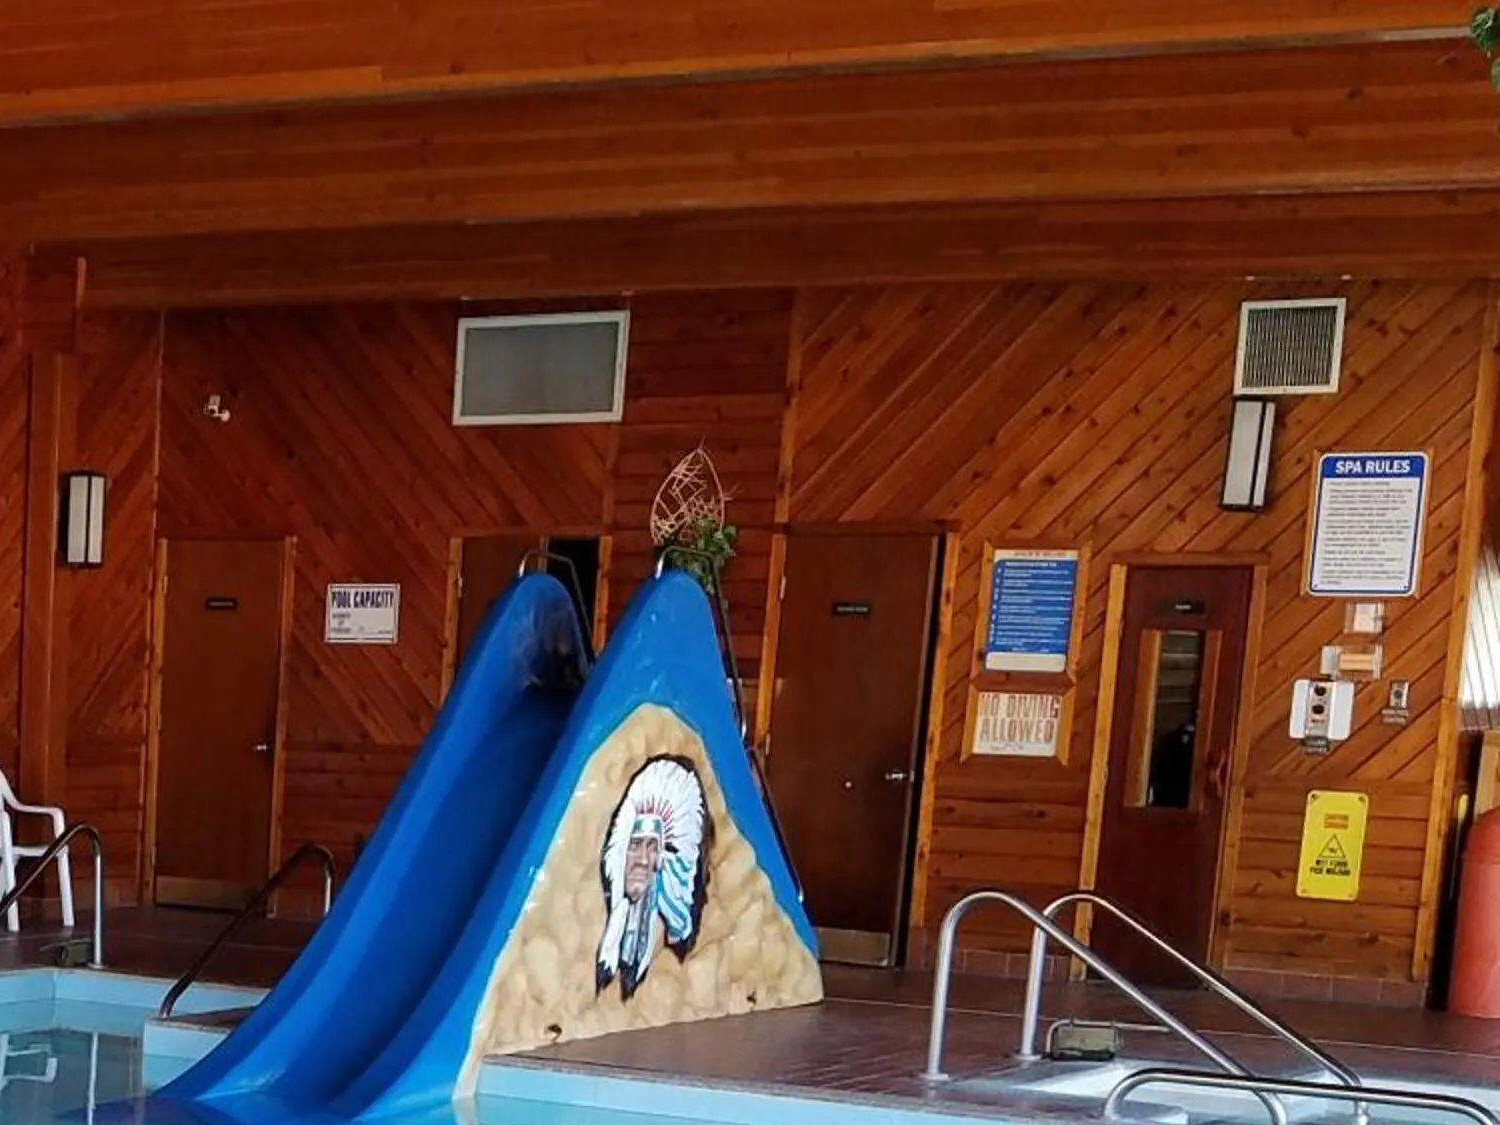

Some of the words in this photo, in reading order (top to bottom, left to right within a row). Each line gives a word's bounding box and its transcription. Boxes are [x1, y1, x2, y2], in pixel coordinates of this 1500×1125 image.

[1335, 459, 1362, 474] SPA
[1365, 459, 1411, 474] RULES
[332, 591, 351, 608] POOL
[354, 591, 394, 608] CAPACITY
[980, 693, 1000, 717] NO
[1006, 693, 1060, 719] DIVING
[979, 717, 1055, 742] ALLOWED
